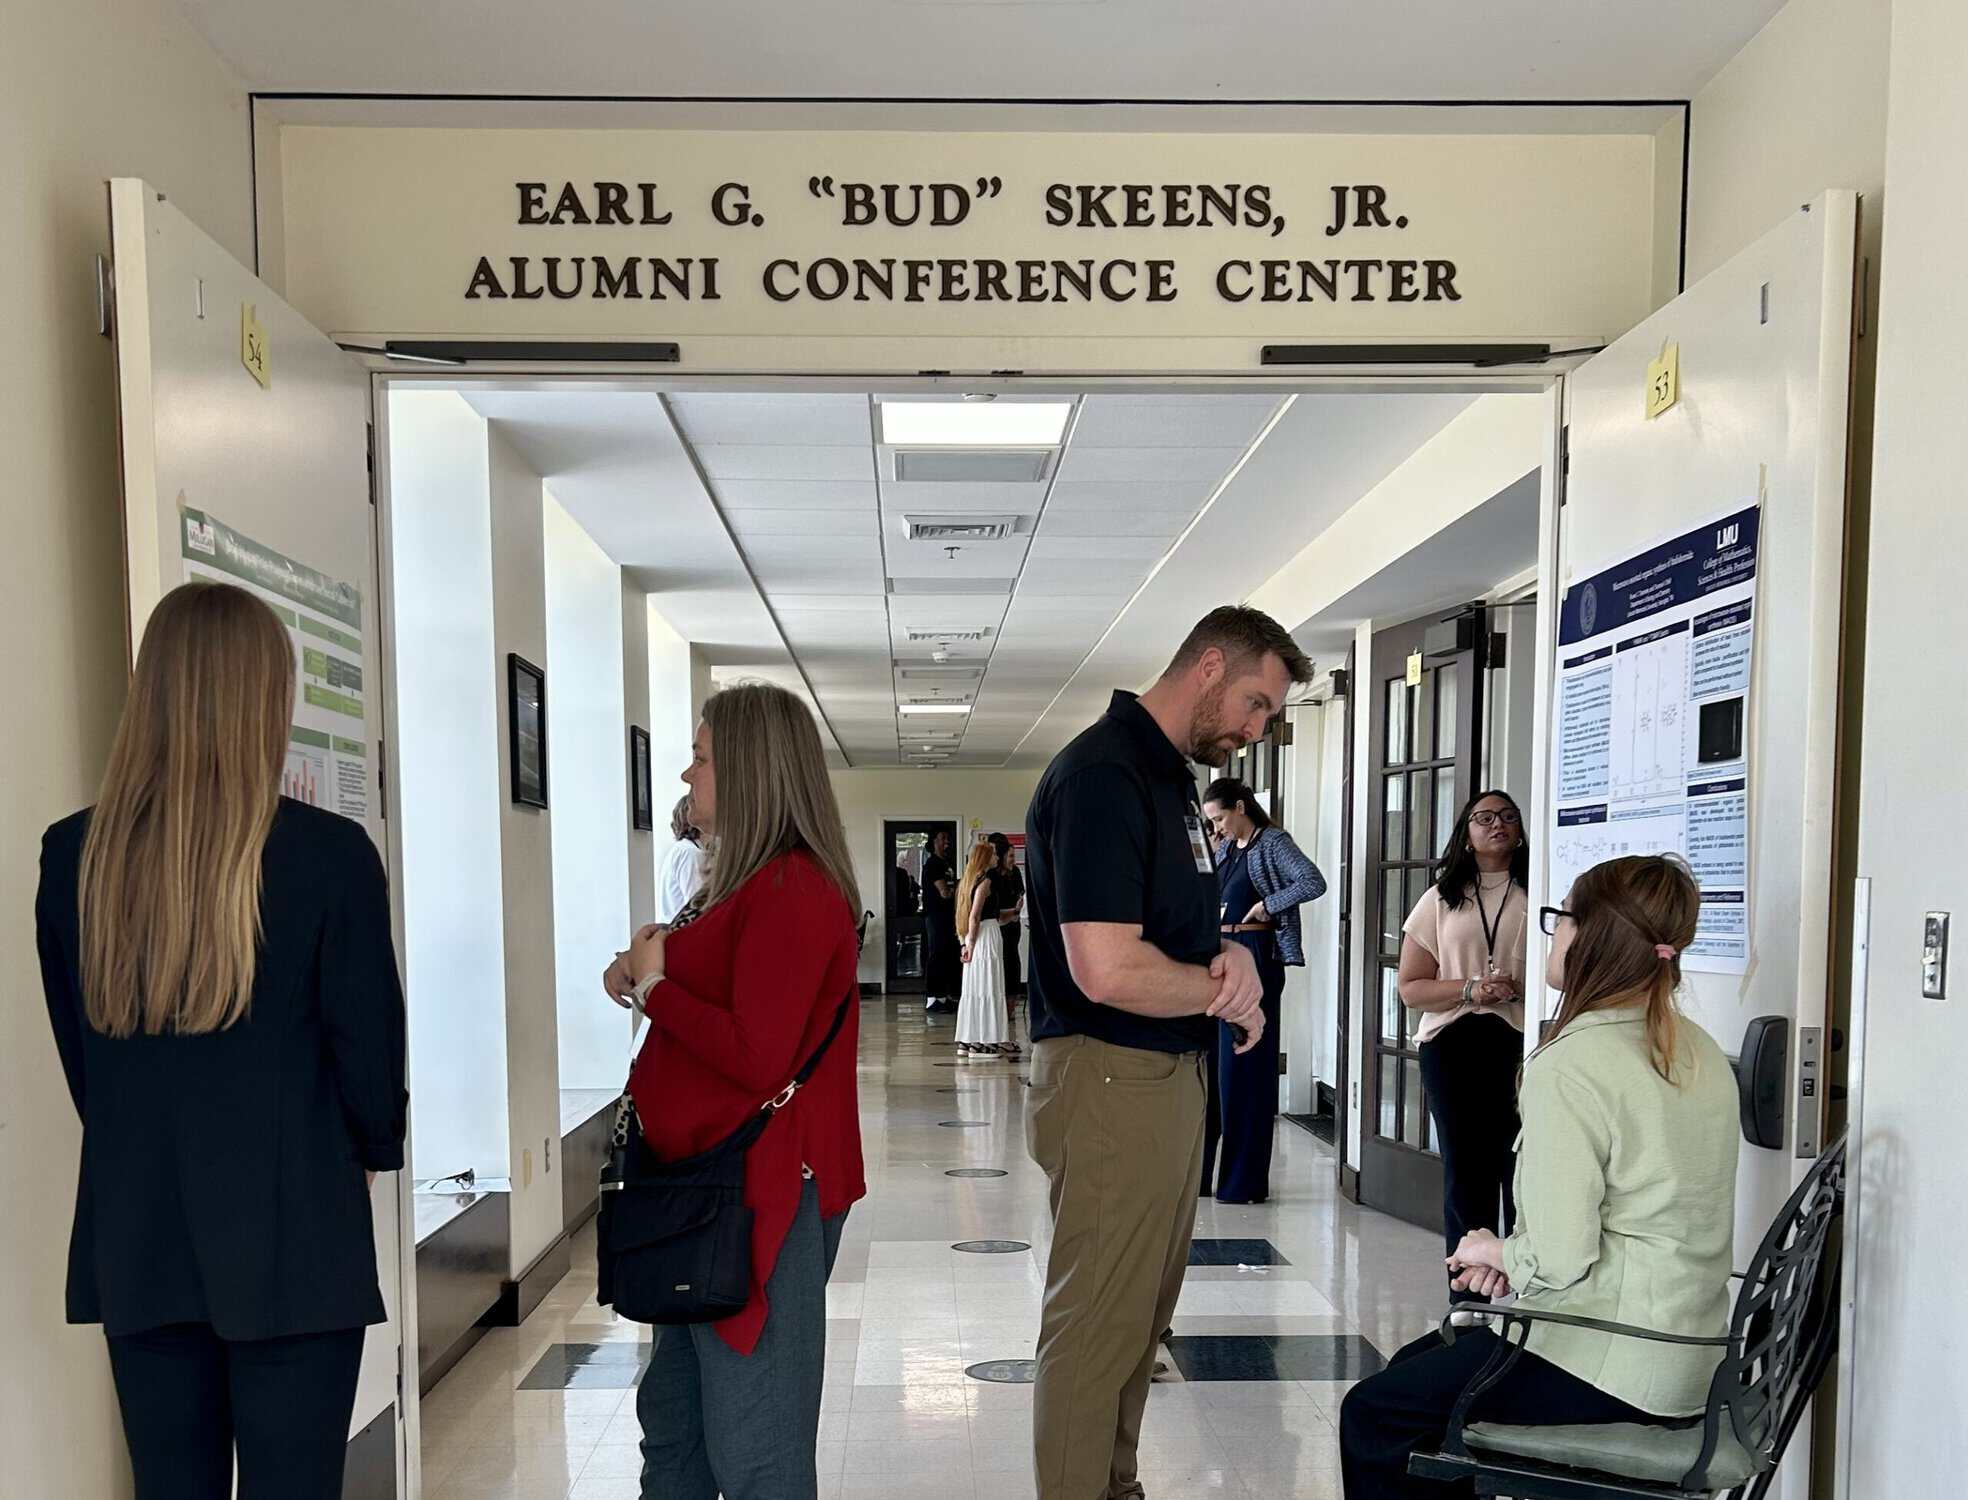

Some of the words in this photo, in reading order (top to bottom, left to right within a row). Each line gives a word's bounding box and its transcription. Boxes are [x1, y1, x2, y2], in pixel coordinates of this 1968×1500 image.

[515, 181, 672, 226] EARL
[711, 181, 764, 228] G.
[1045, 183, 1285, 237] SKEENS,
[1325, 184, 1409, 236] JR.
[464, 256, 721, 300] ALUMNI
[762, 257, 1178, 303] CONFERENCE
[1216, 258, 1462, 303] CENTER
[248, 332, 263, 372] 54
[1653, 370, 1669, 407] 53
[1716, 523, 1739, 549] LMU
